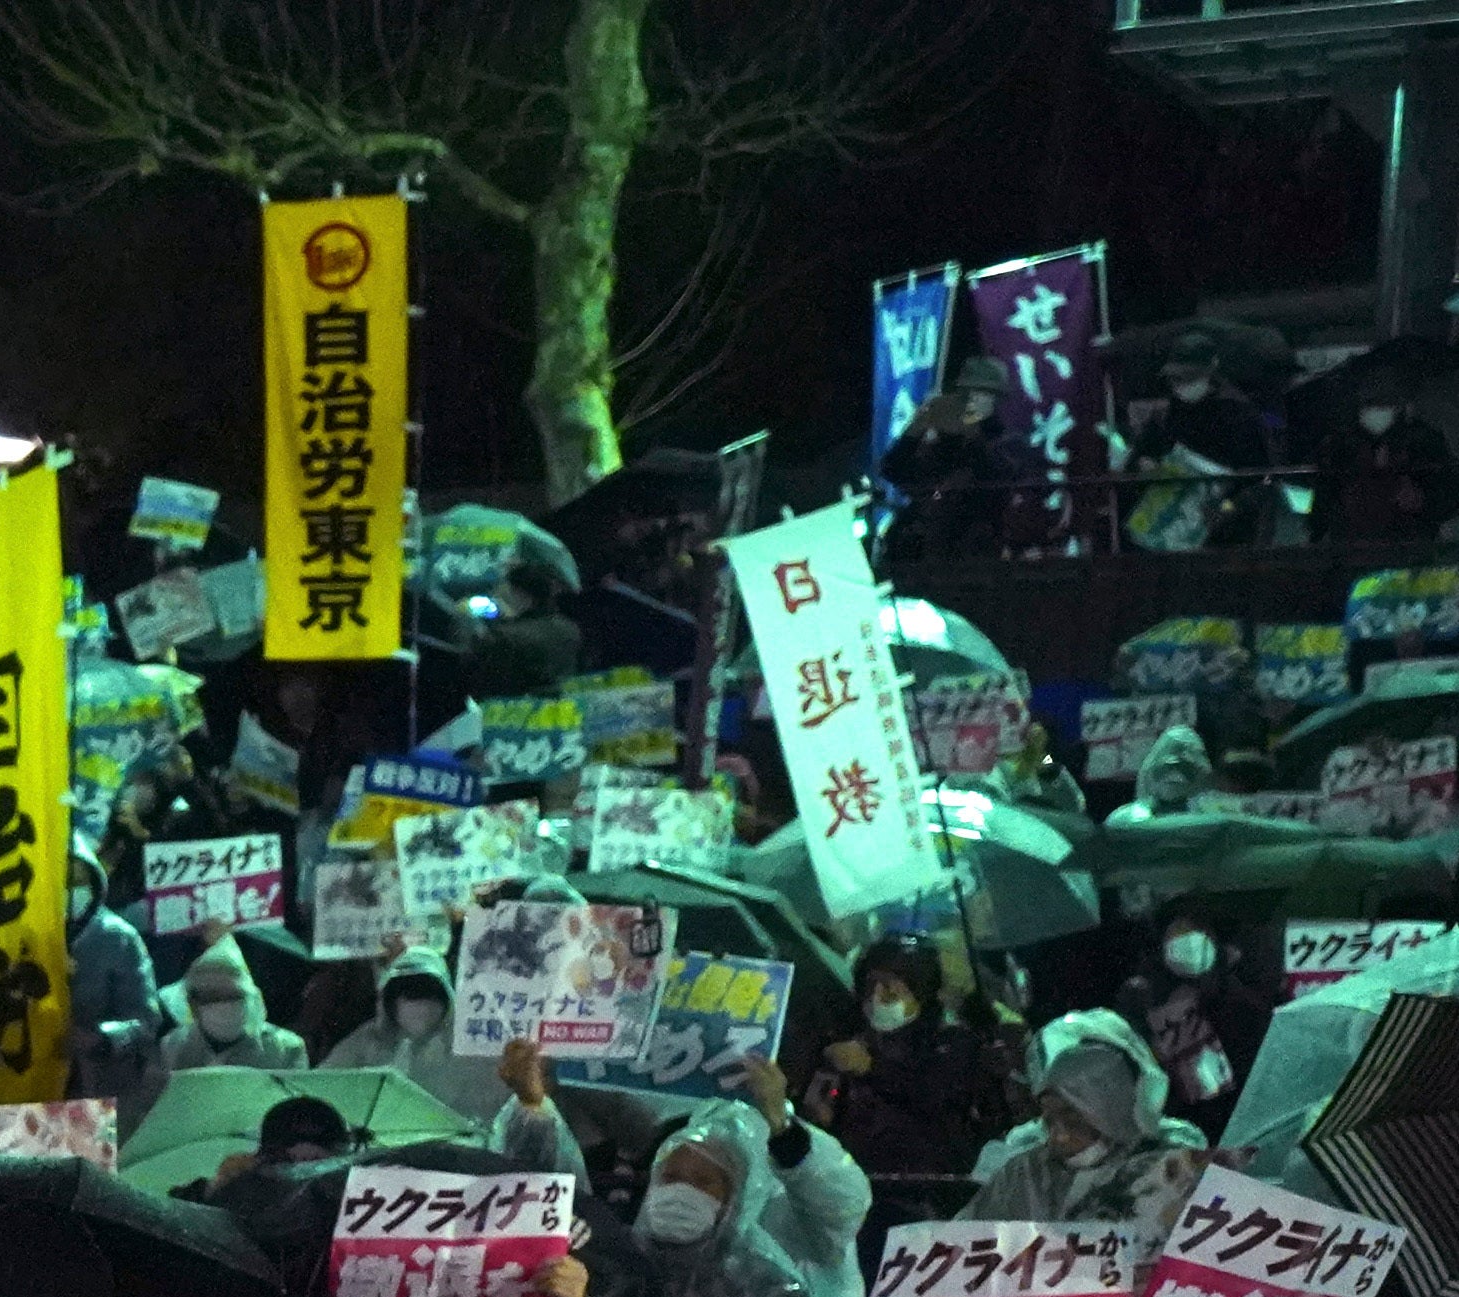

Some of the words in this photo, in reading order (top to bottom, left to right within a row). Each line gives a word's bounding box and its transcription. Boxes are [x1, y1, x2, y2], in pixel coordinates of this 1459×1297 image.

[298, 304, 375, 633] 自治労東京
[342, 1179, 569, 1235] ウクライナから
[1180, 1196, 1398, 1297] ウクライナから
